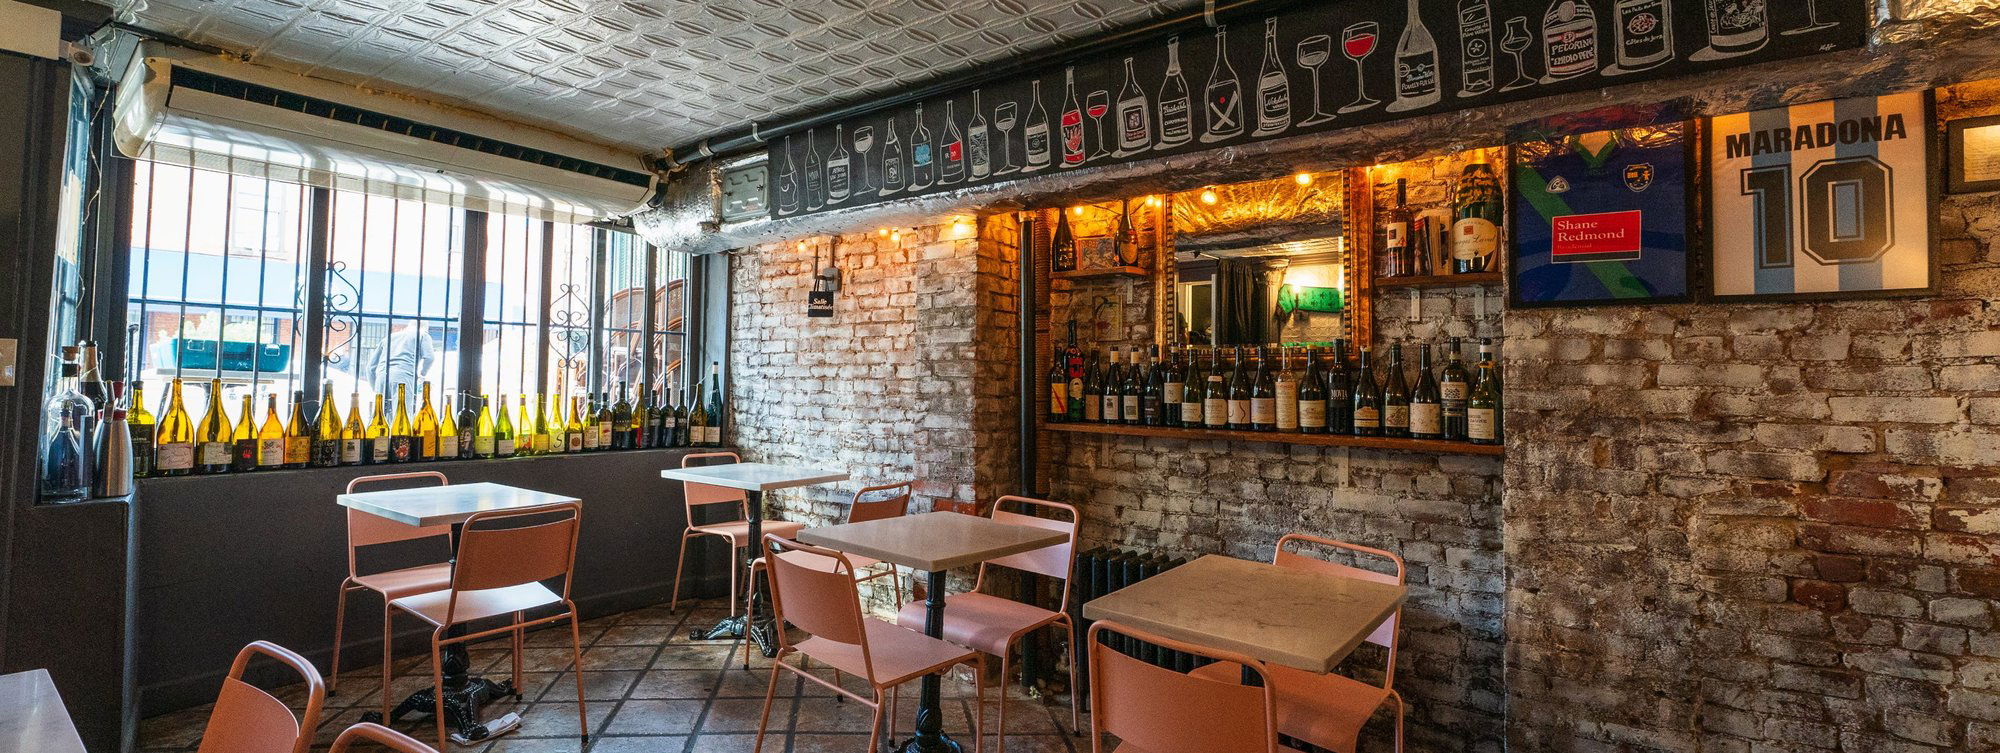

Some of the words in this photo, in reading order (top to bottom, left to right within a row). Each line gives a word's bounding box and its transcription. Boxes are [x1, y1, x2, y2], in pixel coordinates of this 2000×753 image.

[1725, 113, 1907, 160] MARADONA
[1557, 220, 1599, 231] Shane
[1741, 154, 1895, 269] 10
[1557, 228, 1625, 242] Redmond
